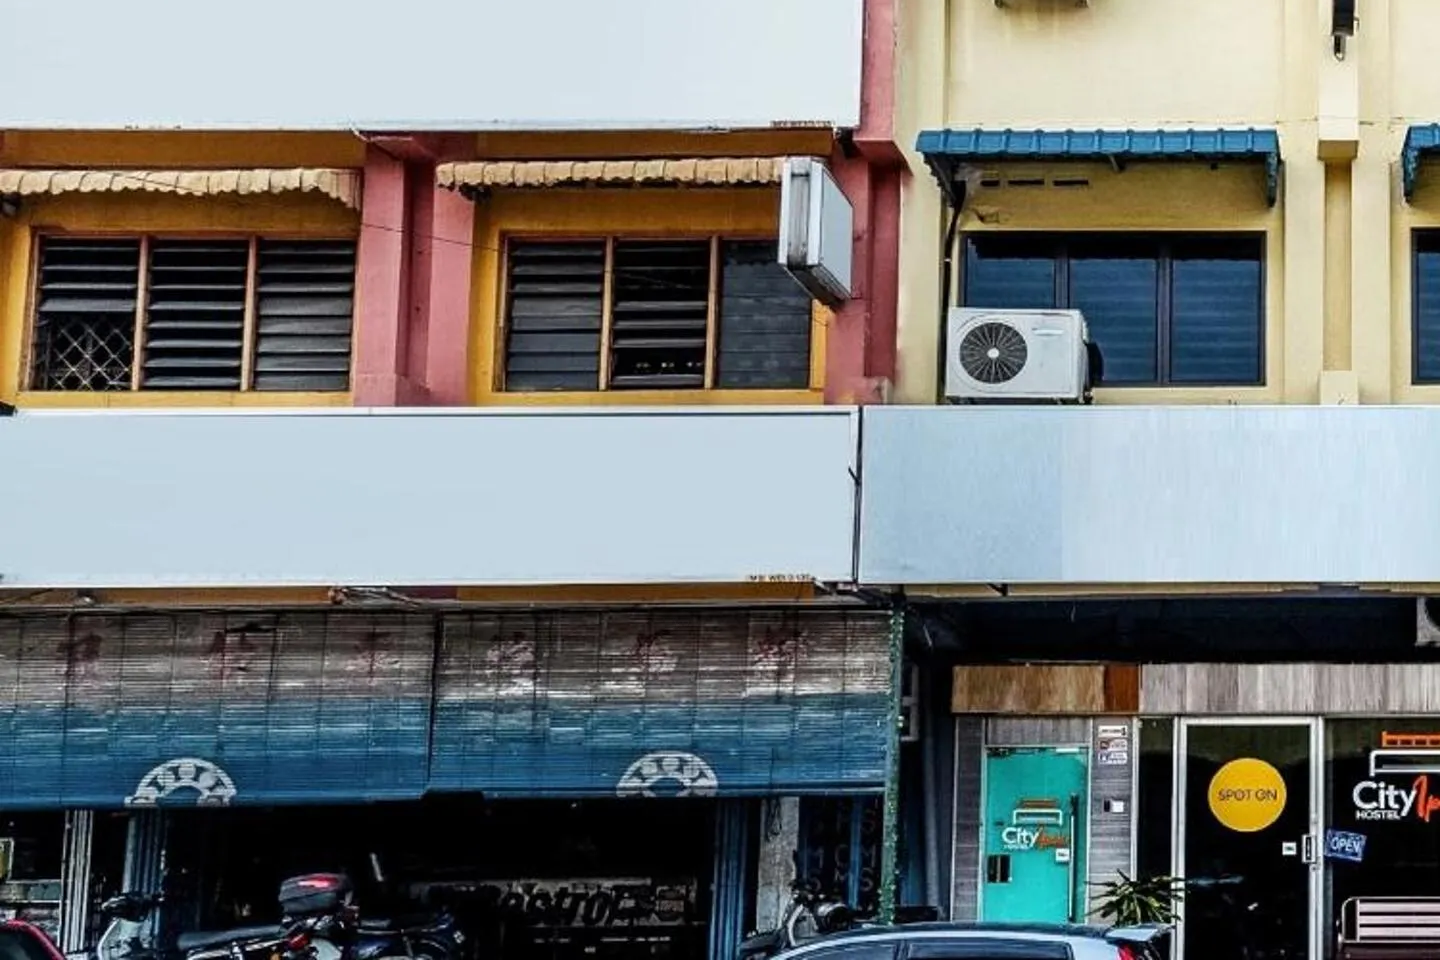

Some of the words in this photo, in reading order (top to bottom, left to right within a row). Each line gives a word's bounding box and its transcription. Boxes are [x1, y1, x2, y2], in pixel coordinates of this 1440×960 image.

[1218, 787, 1253, 801] SPOT
[1255, 787, 1278, 801] ON
[1352, 780, 1419, 817] City
[1355, 809, 1401, 821] HOSTEL
[1002, 825, 1042, 848] City
[1330, 836, 1361, 854] OPEN
